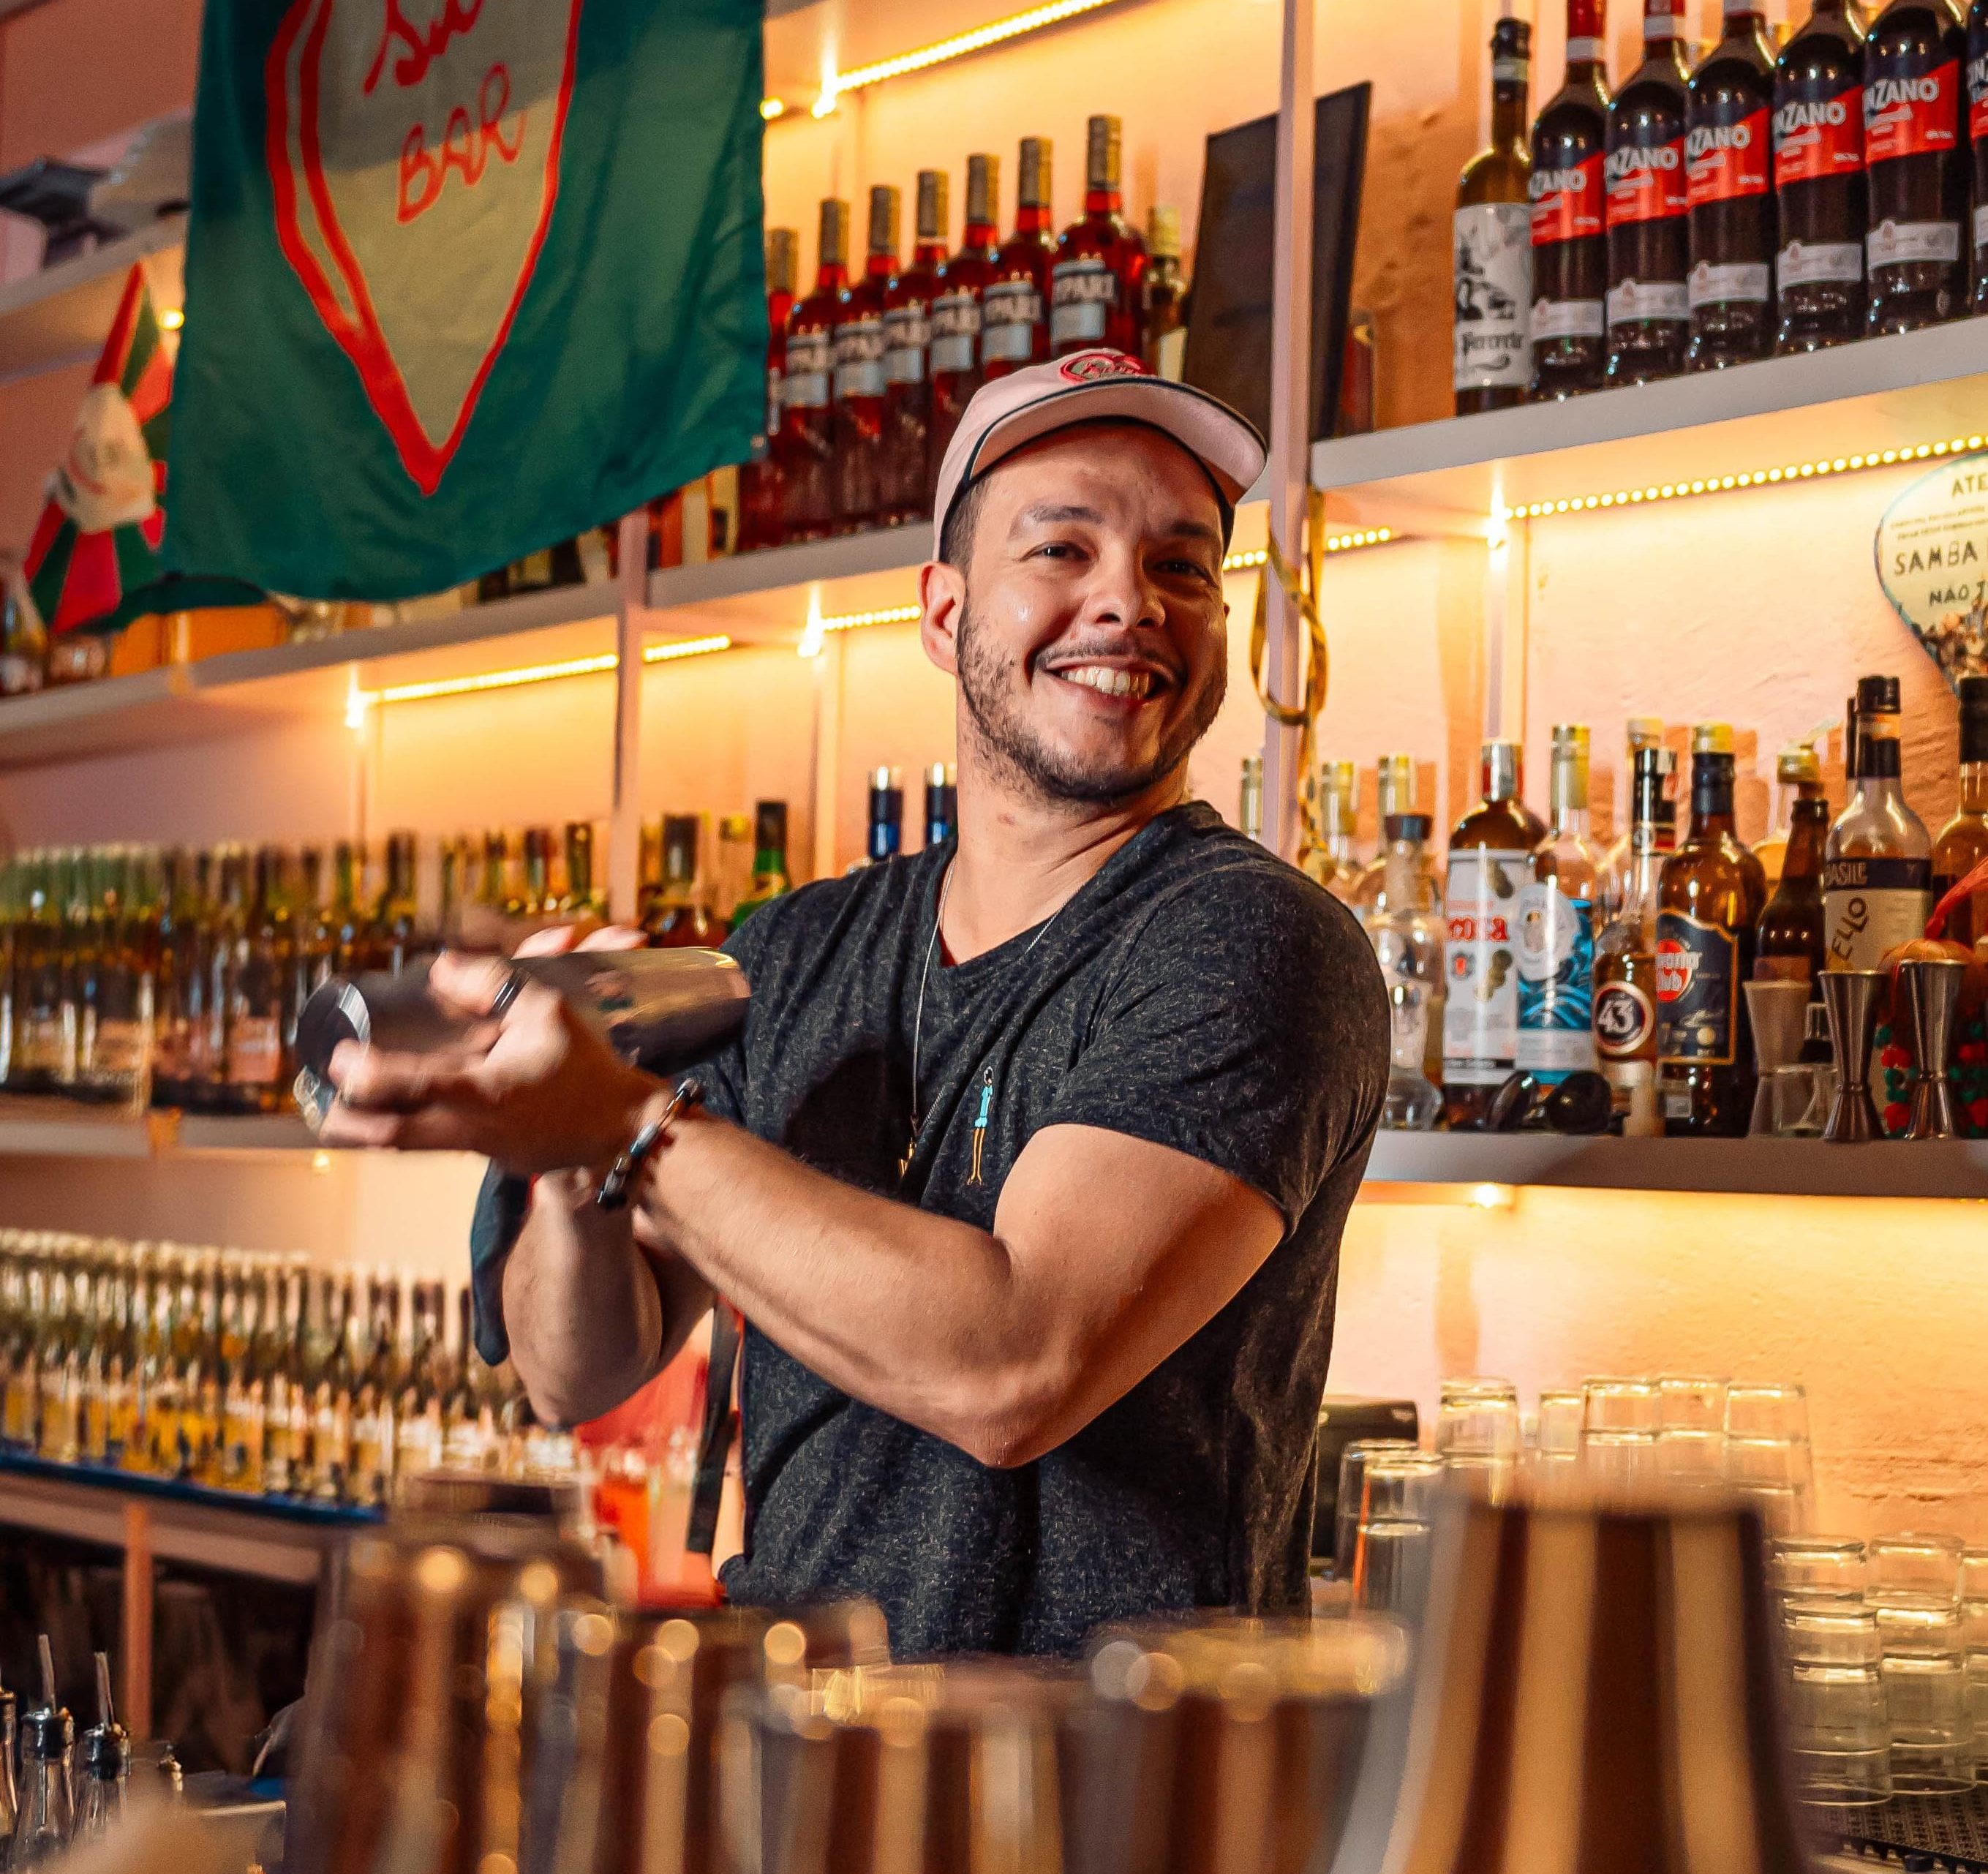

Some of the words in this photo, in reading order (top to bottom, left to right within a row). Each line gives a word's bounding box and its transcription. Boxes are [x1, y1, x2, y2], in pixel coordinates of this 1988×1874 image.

[395, 61, 527, 225] BAR
[1894, 540, 1978, 577] SAMBA
[1831, 897, 1870, 962] ELLO
[1597, 998, 1635, 1034] 43
